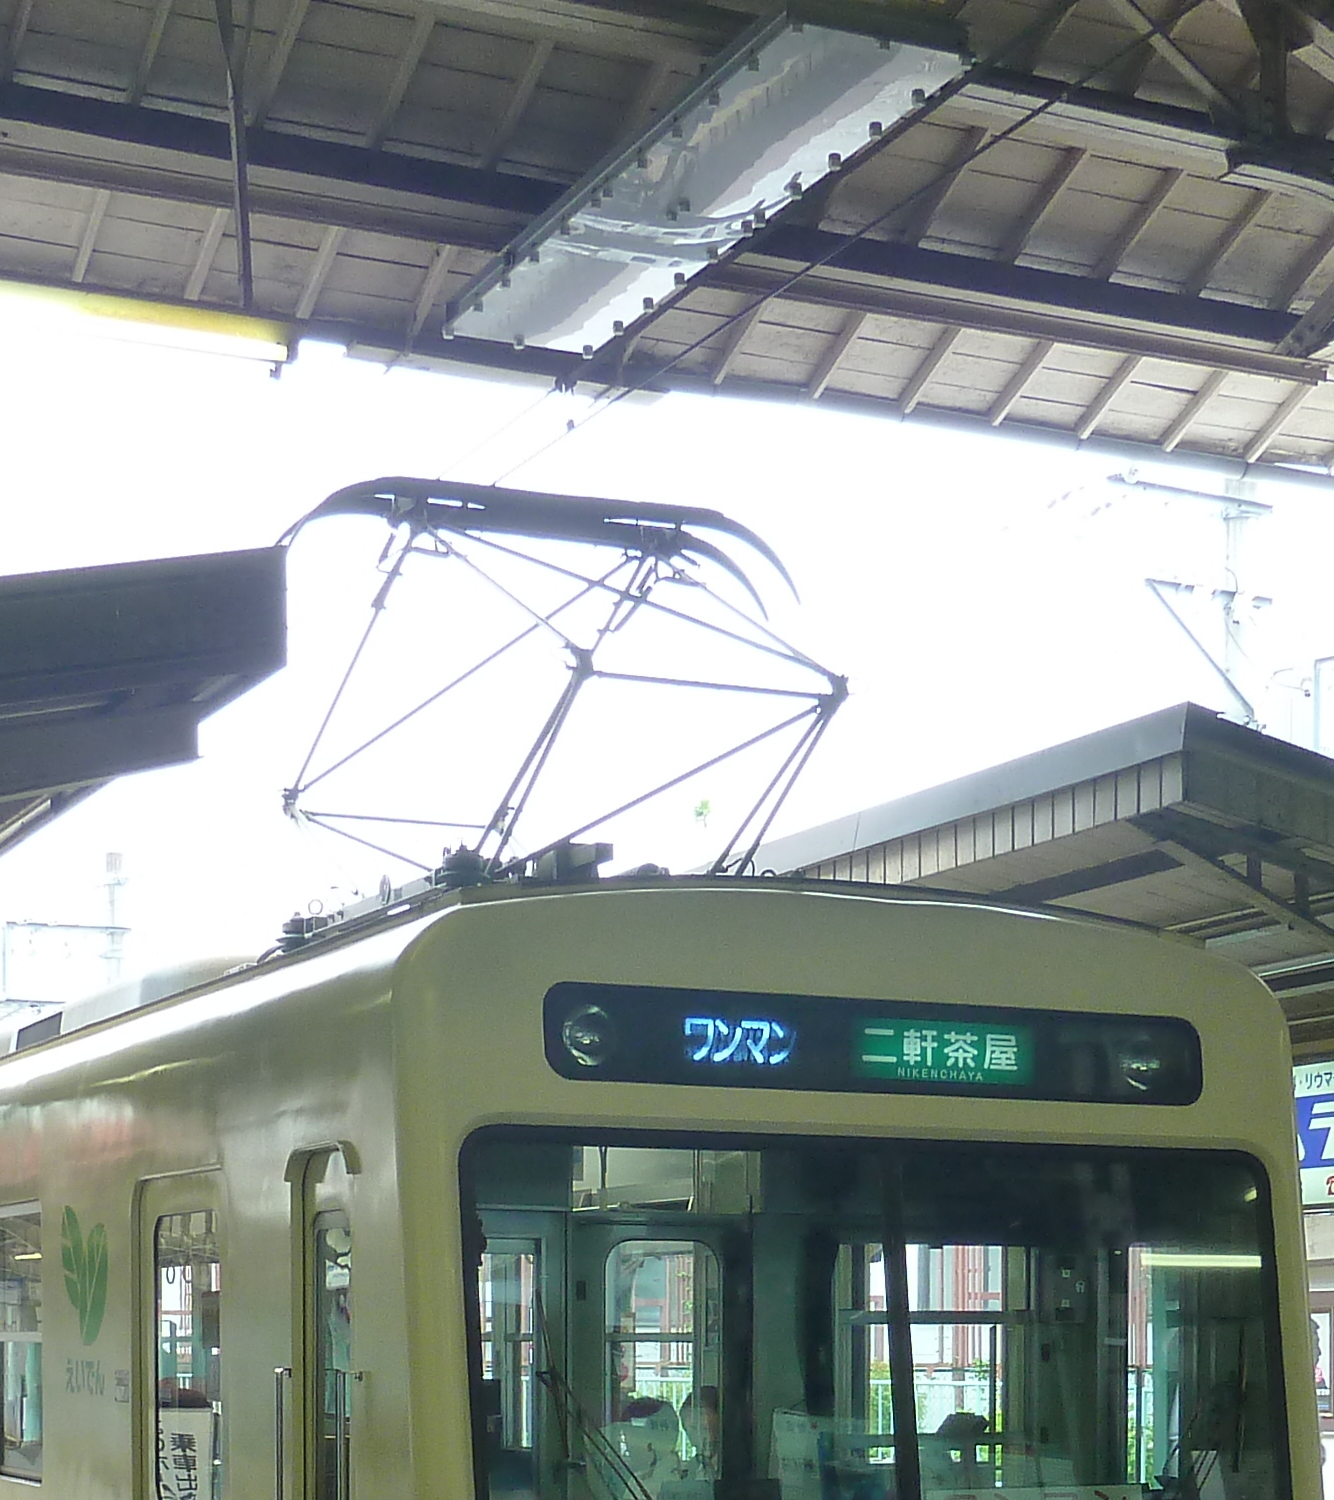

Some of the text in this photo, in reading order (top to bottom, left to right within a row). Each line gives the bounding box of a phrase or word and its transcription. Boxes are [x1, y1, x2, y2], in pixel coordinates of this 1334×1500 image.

[684, 1017, 798, 1064] ワンマン
[861, 1028, 1019, 1072] 二軒茶屋
[896, 1066, 985, 1082] NIKENCHAYA
